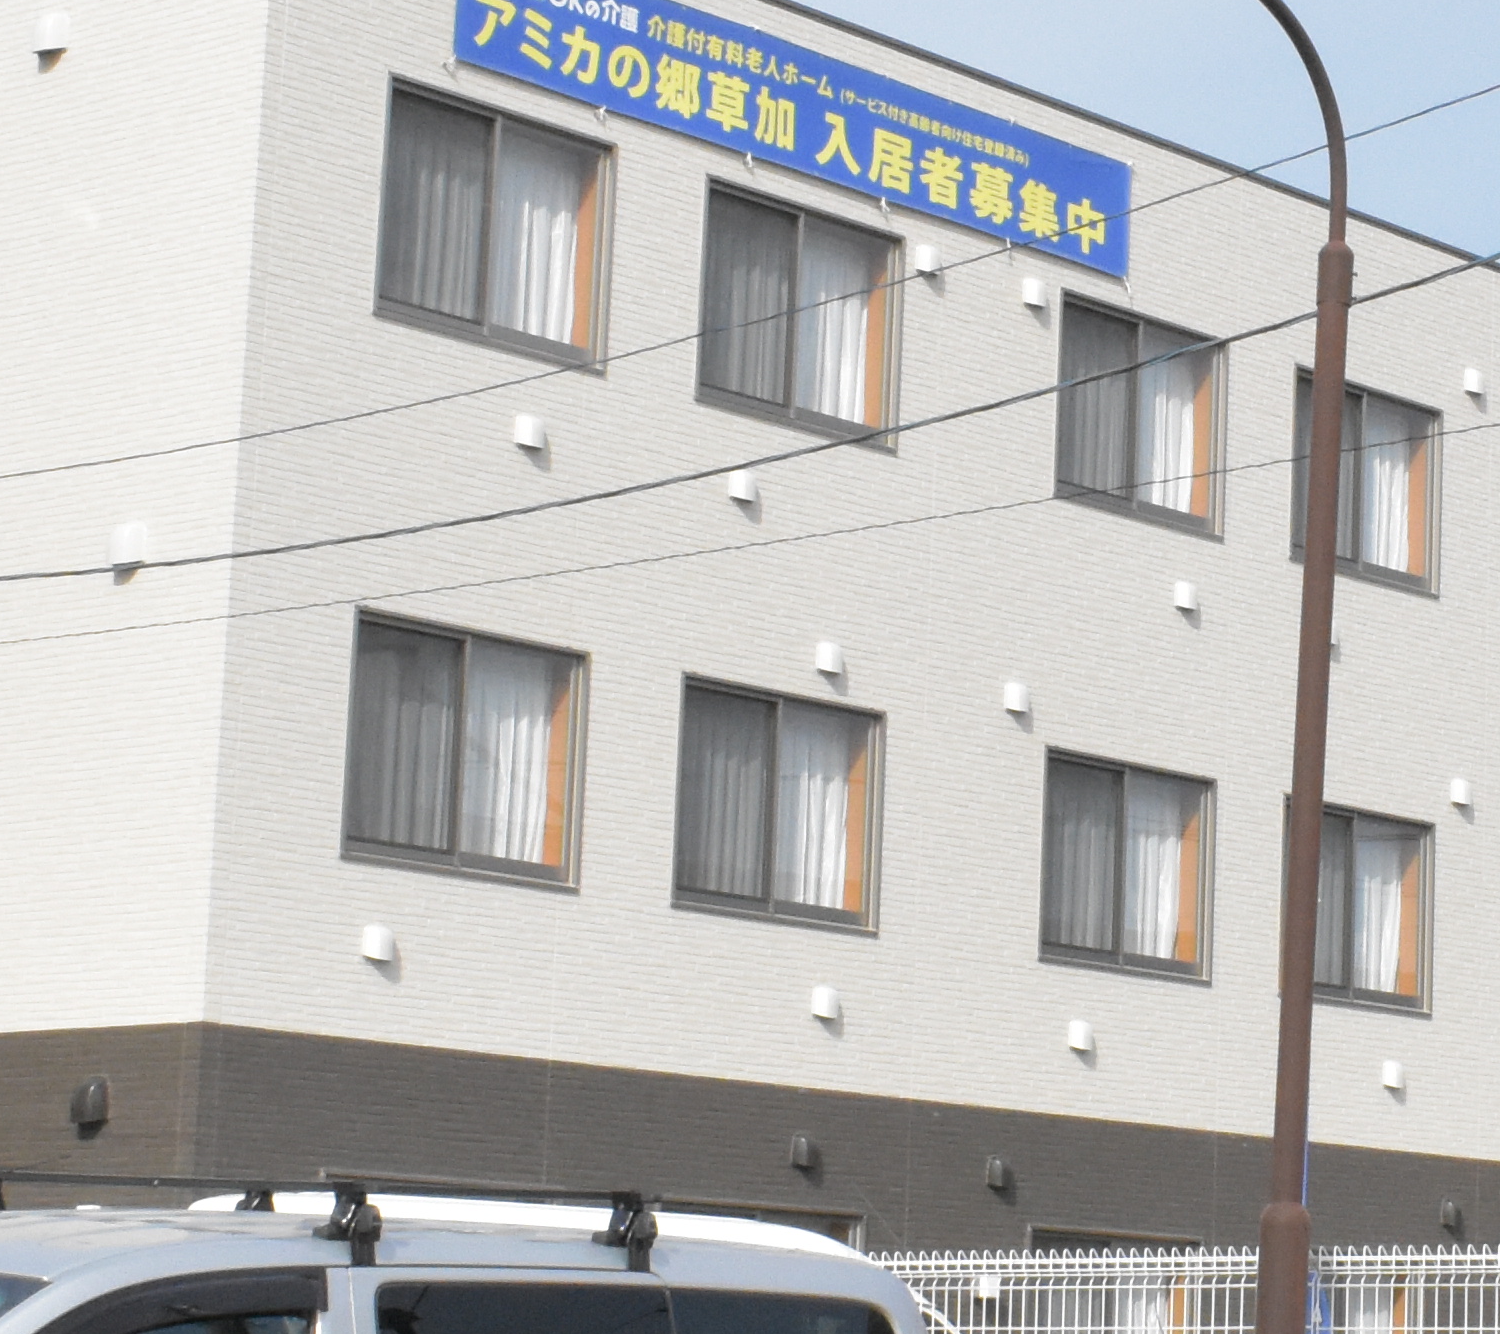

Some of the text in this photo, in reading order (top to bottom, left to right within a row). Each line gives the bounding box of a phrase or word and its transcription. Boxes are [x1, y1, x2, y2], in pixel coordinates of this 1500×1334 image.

[647, 14, 834, 100] 介護付有料老人ホーム
[815, 111, 1106, 255] 入居者募集中
